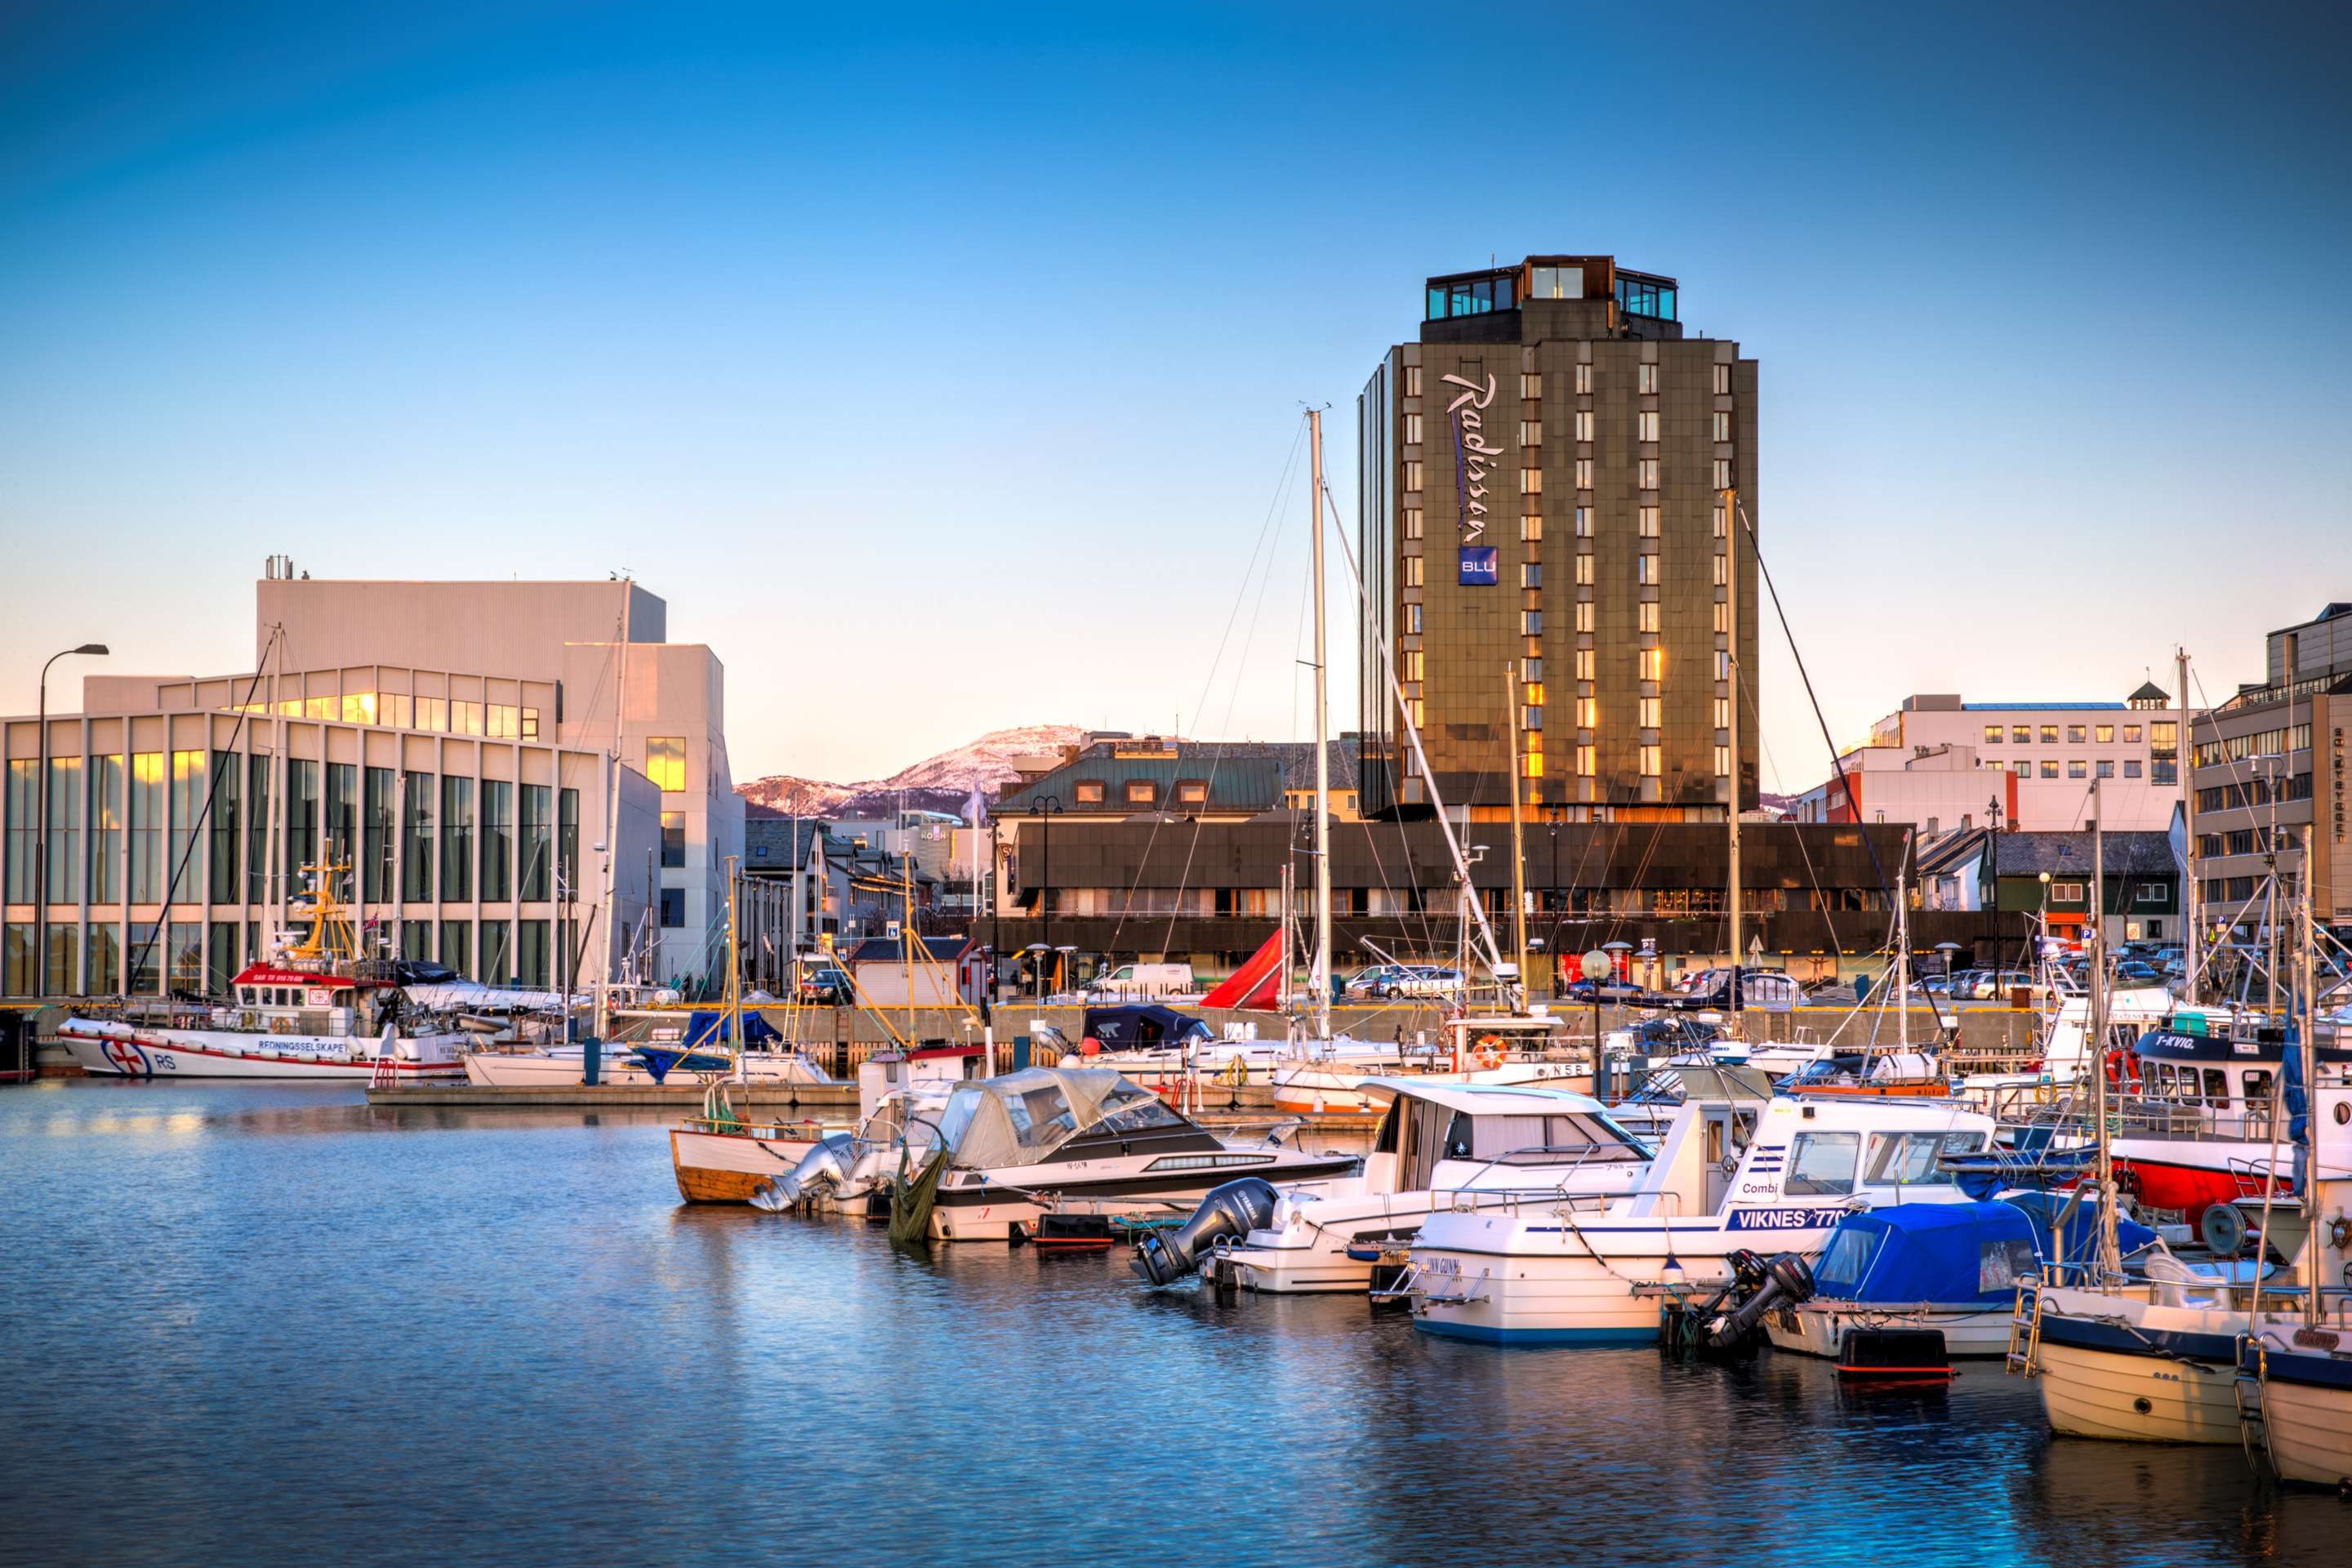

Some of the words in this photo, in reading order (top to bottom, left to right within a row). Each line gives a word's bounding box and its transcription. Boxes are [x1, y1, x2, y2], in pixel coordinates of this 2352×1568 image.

[1440, 372, 1504, 543] Radisson
[1462, 561, 1496, 572] BLU
[920, 830, 947, 840] KOH
[154, 1054, 176, 1070] RS
[1742, 1183, 1779, 1193] Combi
[1241, 1196, 1258, 1221] YAMAHA
[1738, 1209, 1806, 1228] VIKNES
